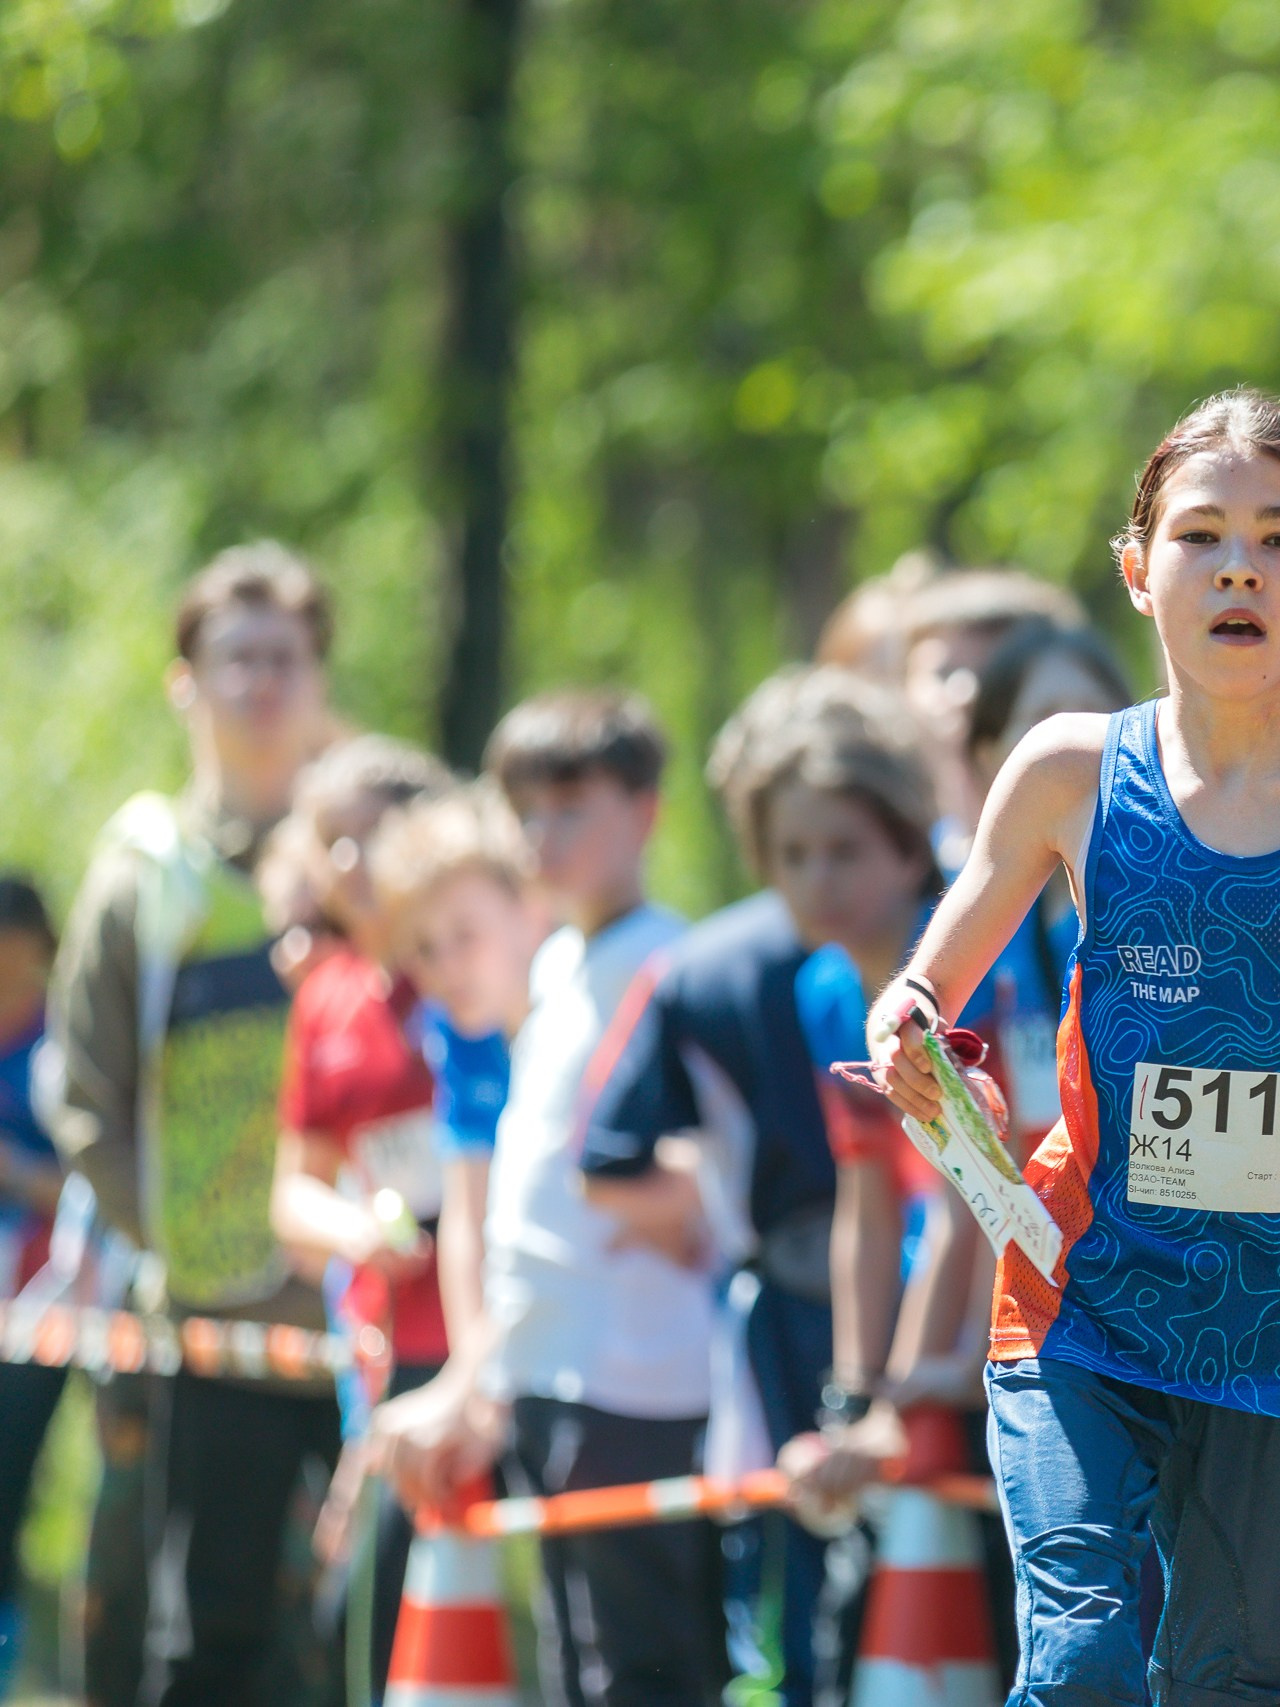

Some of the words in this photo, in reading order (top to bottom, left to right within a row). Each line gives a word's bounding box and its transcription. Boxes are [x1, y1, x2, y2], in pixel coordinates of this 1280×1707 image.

[1117, 945, 1202, 977] READ
[1130, 981, 1157, 1001] THE
[1159, 986, 1200, 1003] MAP
[1152, 1067, 1278, 1136] 511
[1130, 1132, 1192, 1162] Ж14
[1129, 1160, 1166, 1173] Волкова
[1168, 1165, 1195, 1176] Алиса
[1247, 1171, 1273, 1181] Старт
[1159, 1188, 1197, 1200] 8510255
